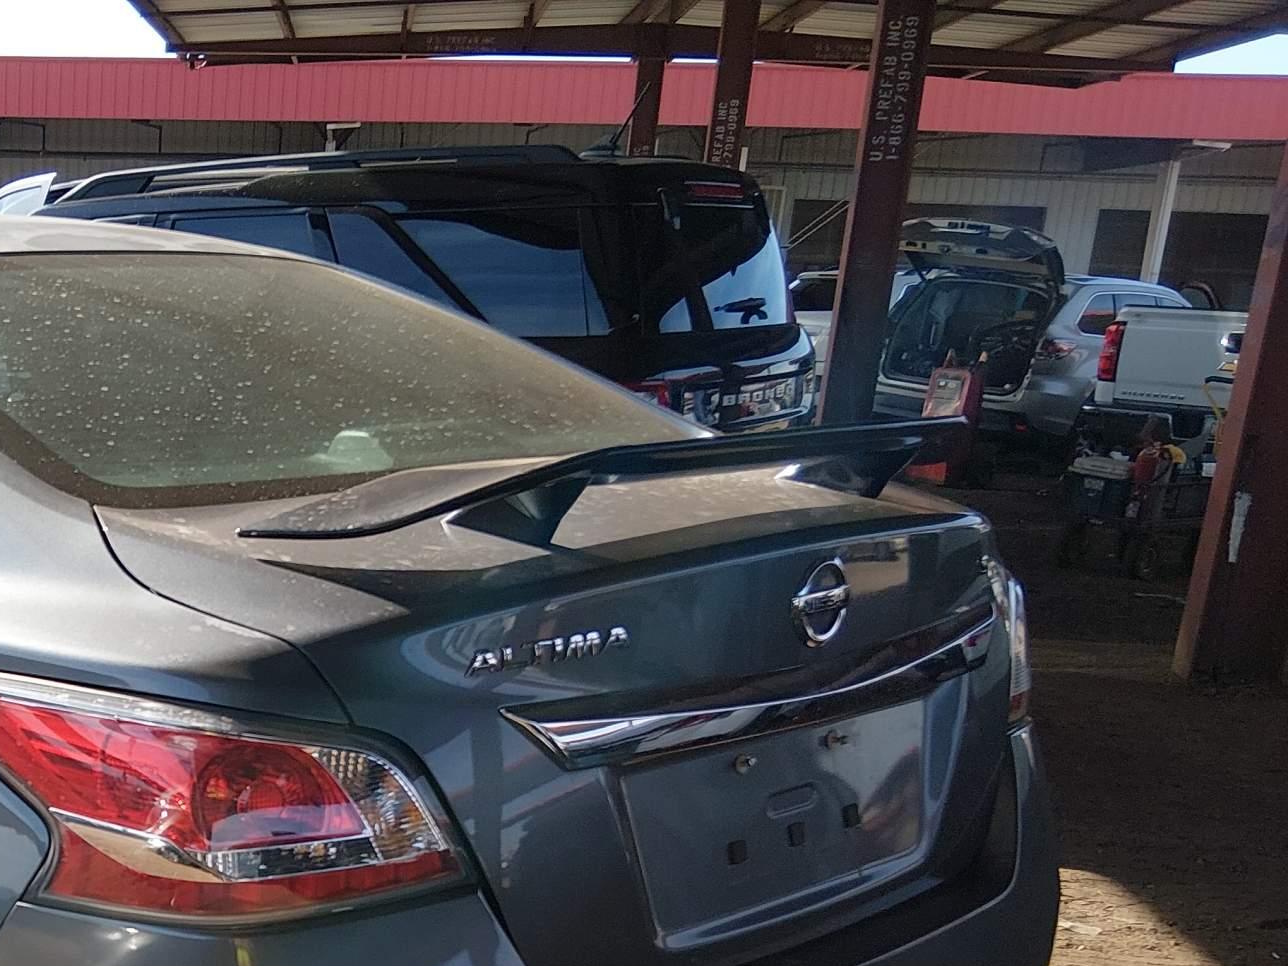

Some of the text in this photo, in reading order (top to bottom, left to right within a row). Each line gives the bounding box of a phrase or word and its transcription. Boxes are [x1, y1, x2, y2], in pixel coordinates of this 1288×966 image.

[869, 16, 903, 161] U.S. PREFAB INC.
[886, 17, 919, 159] 1-866-799-0969
[722, 382, 793, 406] BRONCO
[464, 626, 630, 677] ALTIMA
